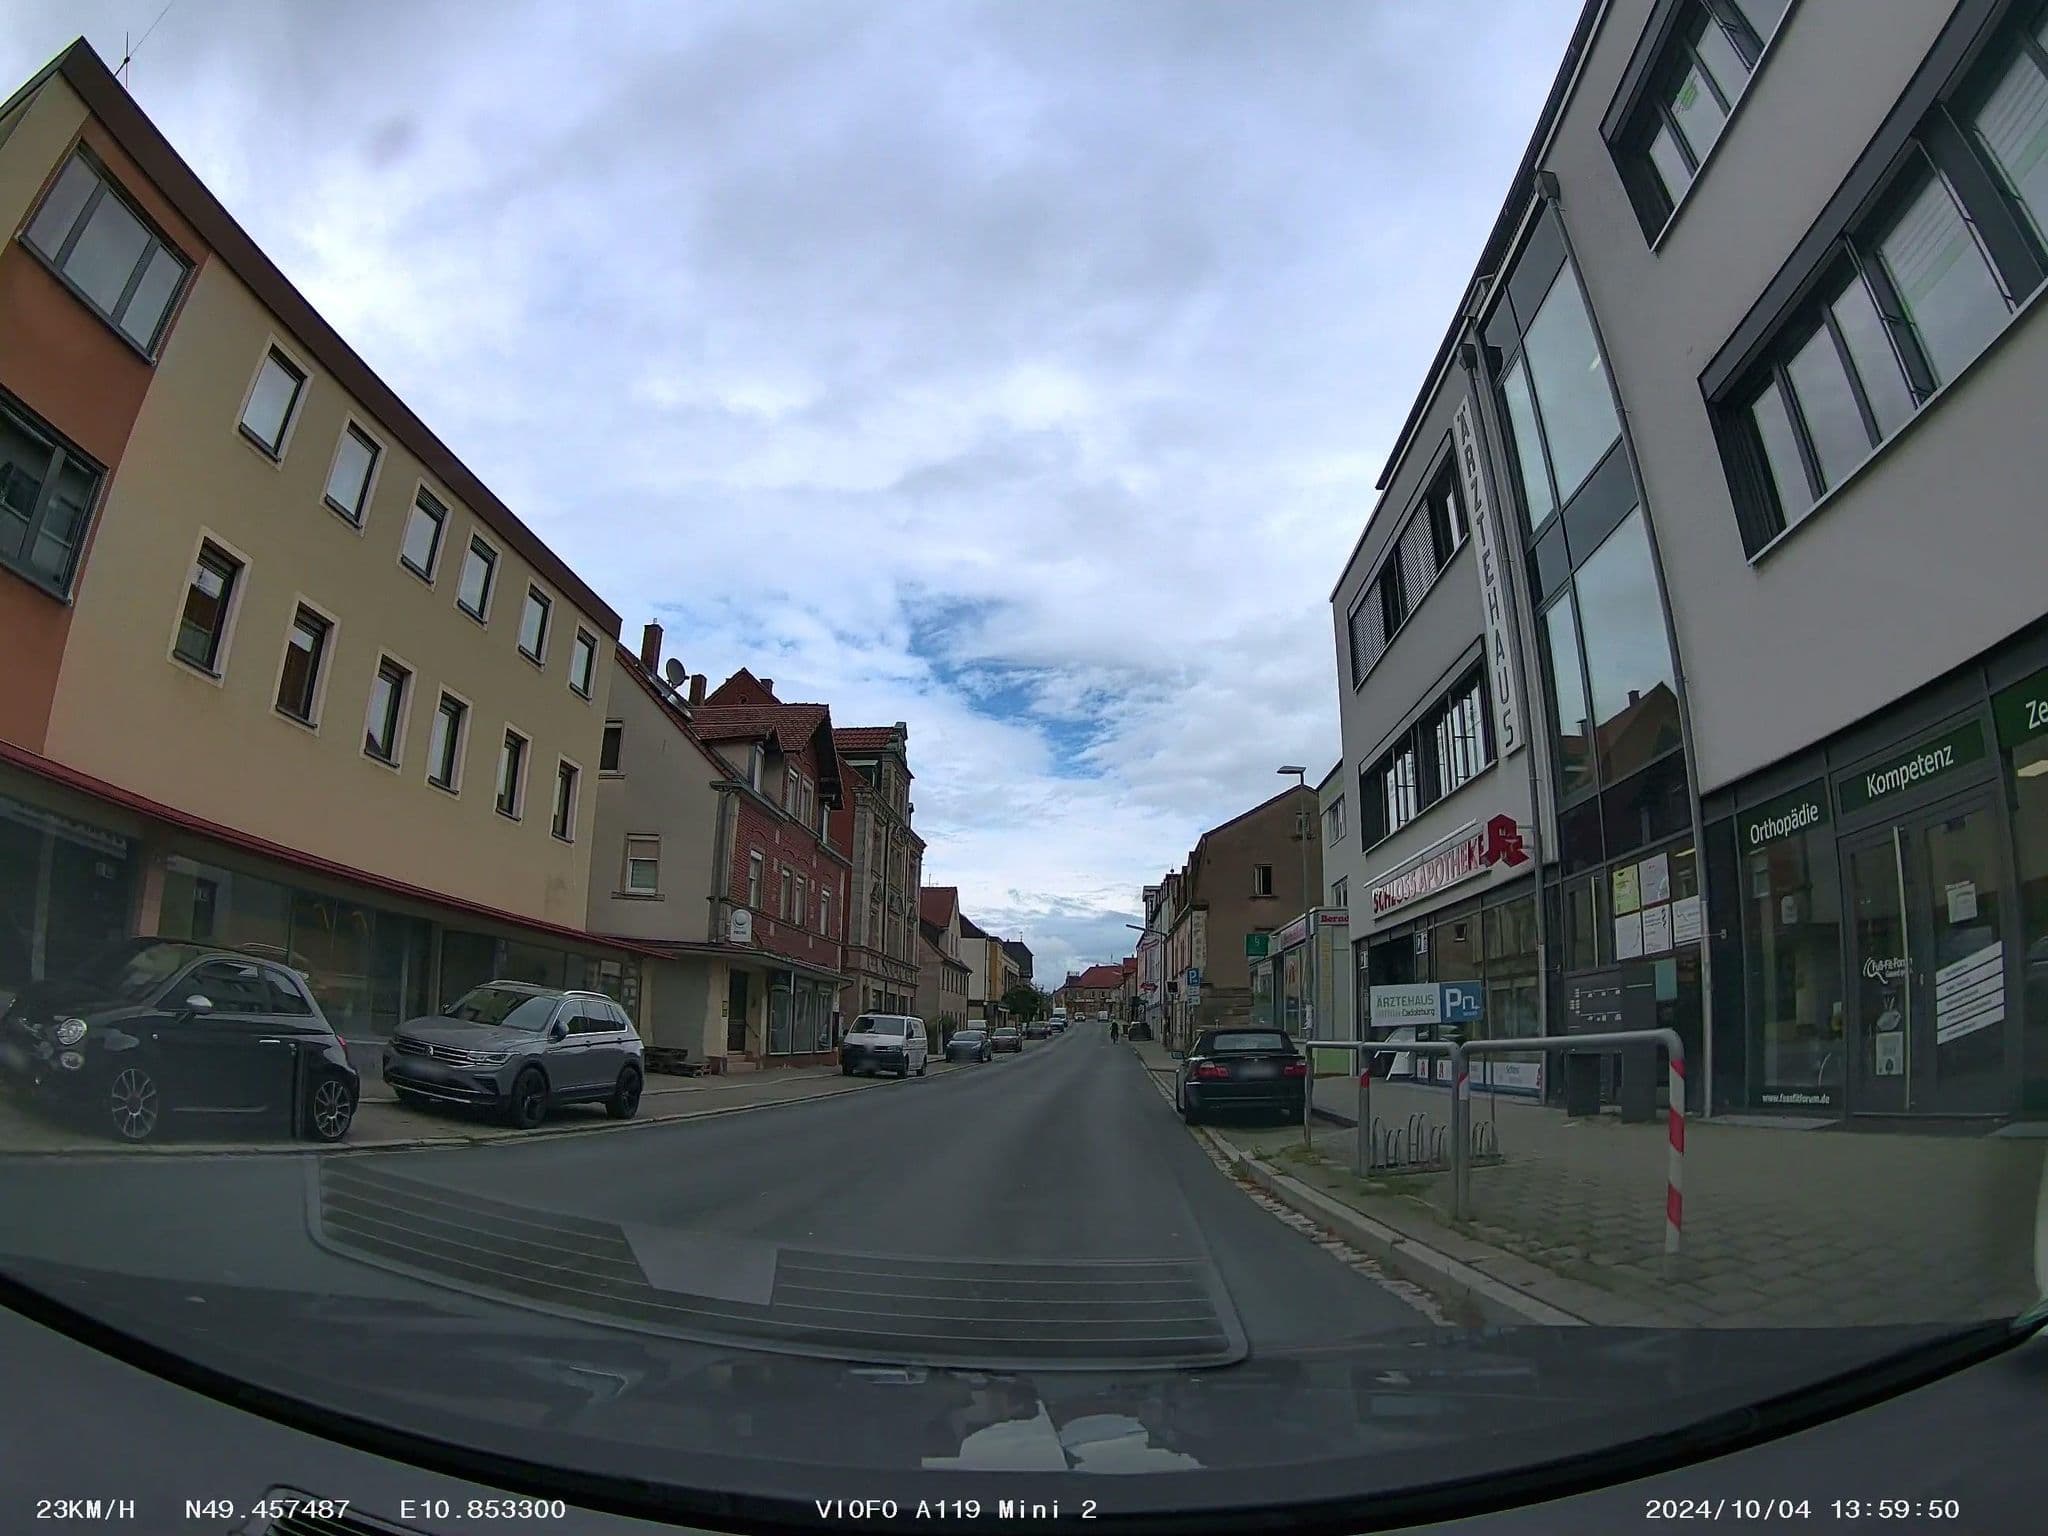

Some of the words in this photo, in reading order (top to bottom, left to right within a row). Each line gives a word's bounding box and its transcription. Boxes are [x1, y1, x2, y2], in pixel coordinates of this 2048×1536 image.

[1456, 405, 1514, 748] ÄRZTEHAUS
[1865, 743, 1955, 799] Kompetenz
[1749, 801, 1820, 846] Orthopädie
[1373, 874, 1417, 914] SCHLOSS
[1376, 994, 1434, 1009] ÄRZTEHAUS
